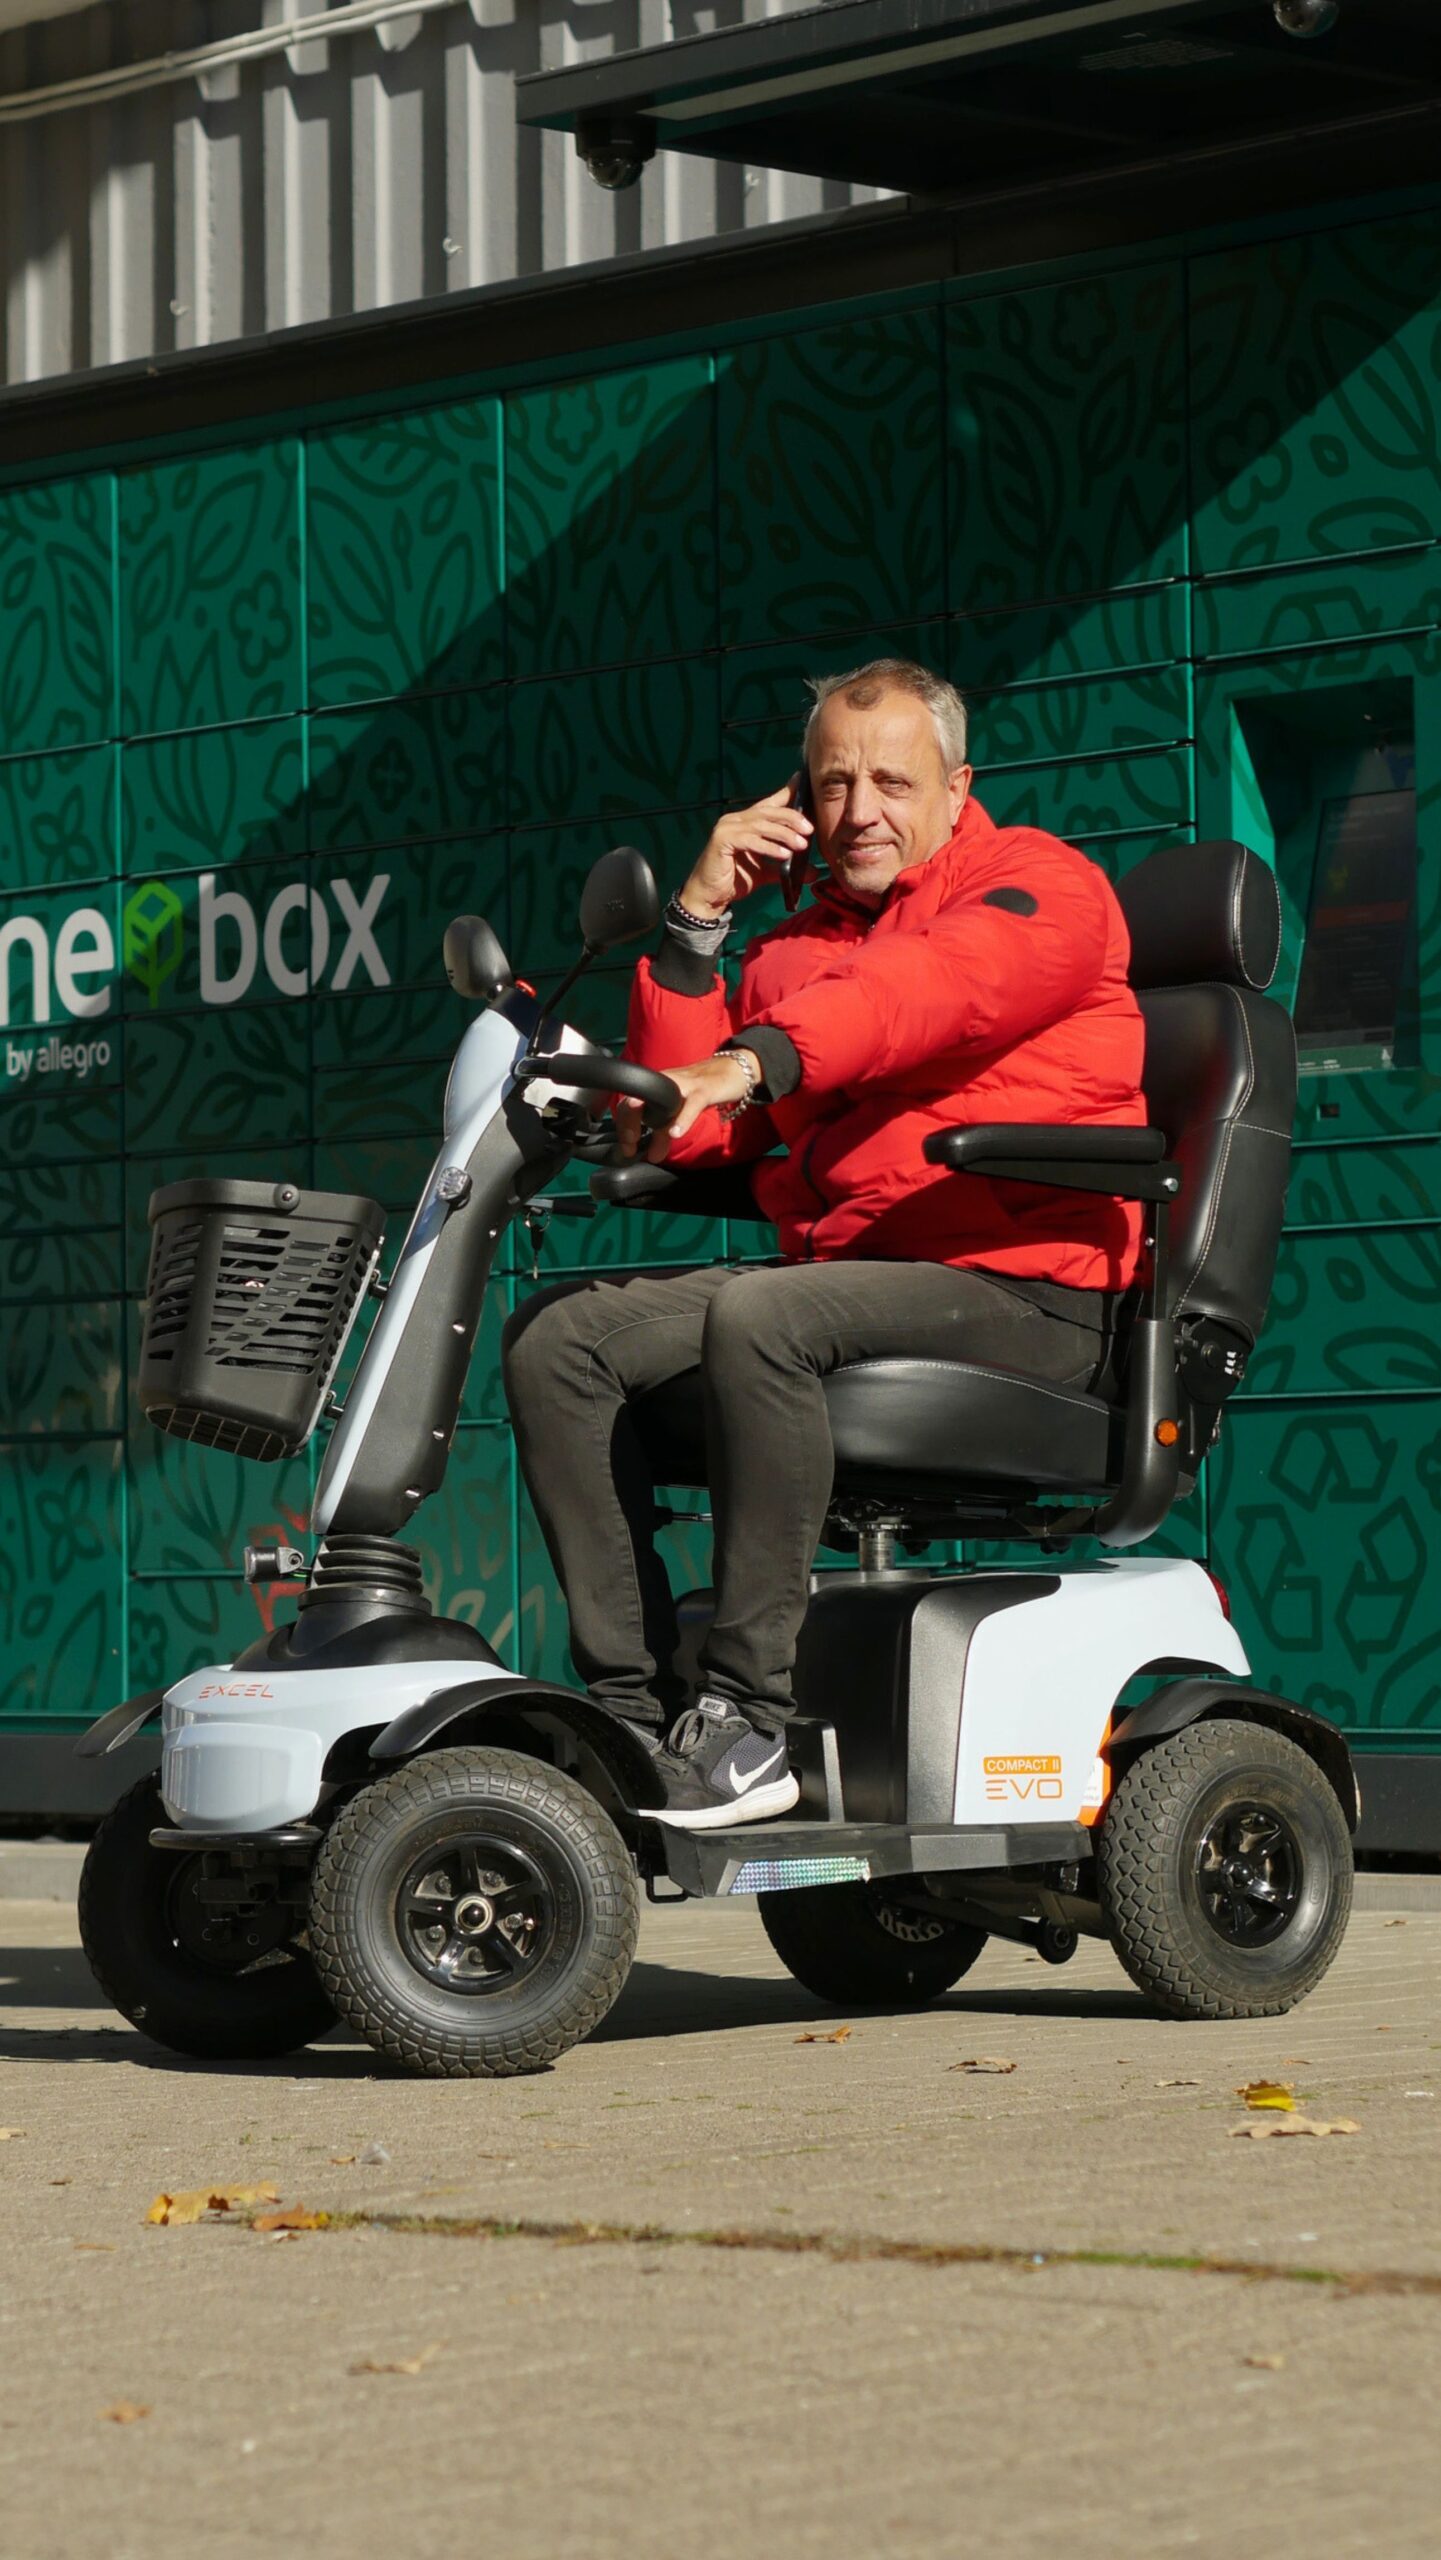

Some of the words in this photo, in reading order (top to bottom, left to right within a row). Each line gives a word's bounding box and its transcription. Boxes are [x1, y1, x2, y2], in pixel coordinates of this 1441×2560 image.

[198, 873, 391, 1004] box
[6, 1041, 33, 1082] by
[36, 1037, 111, 1078] allegro
[198, 1684, 274, 1699] EXCEL
[702, 1700, 722, 1713] NIKE
[987, 1759, 1048, 1772] COMPACT
[985, 1778, 1062, 1800] EVO
